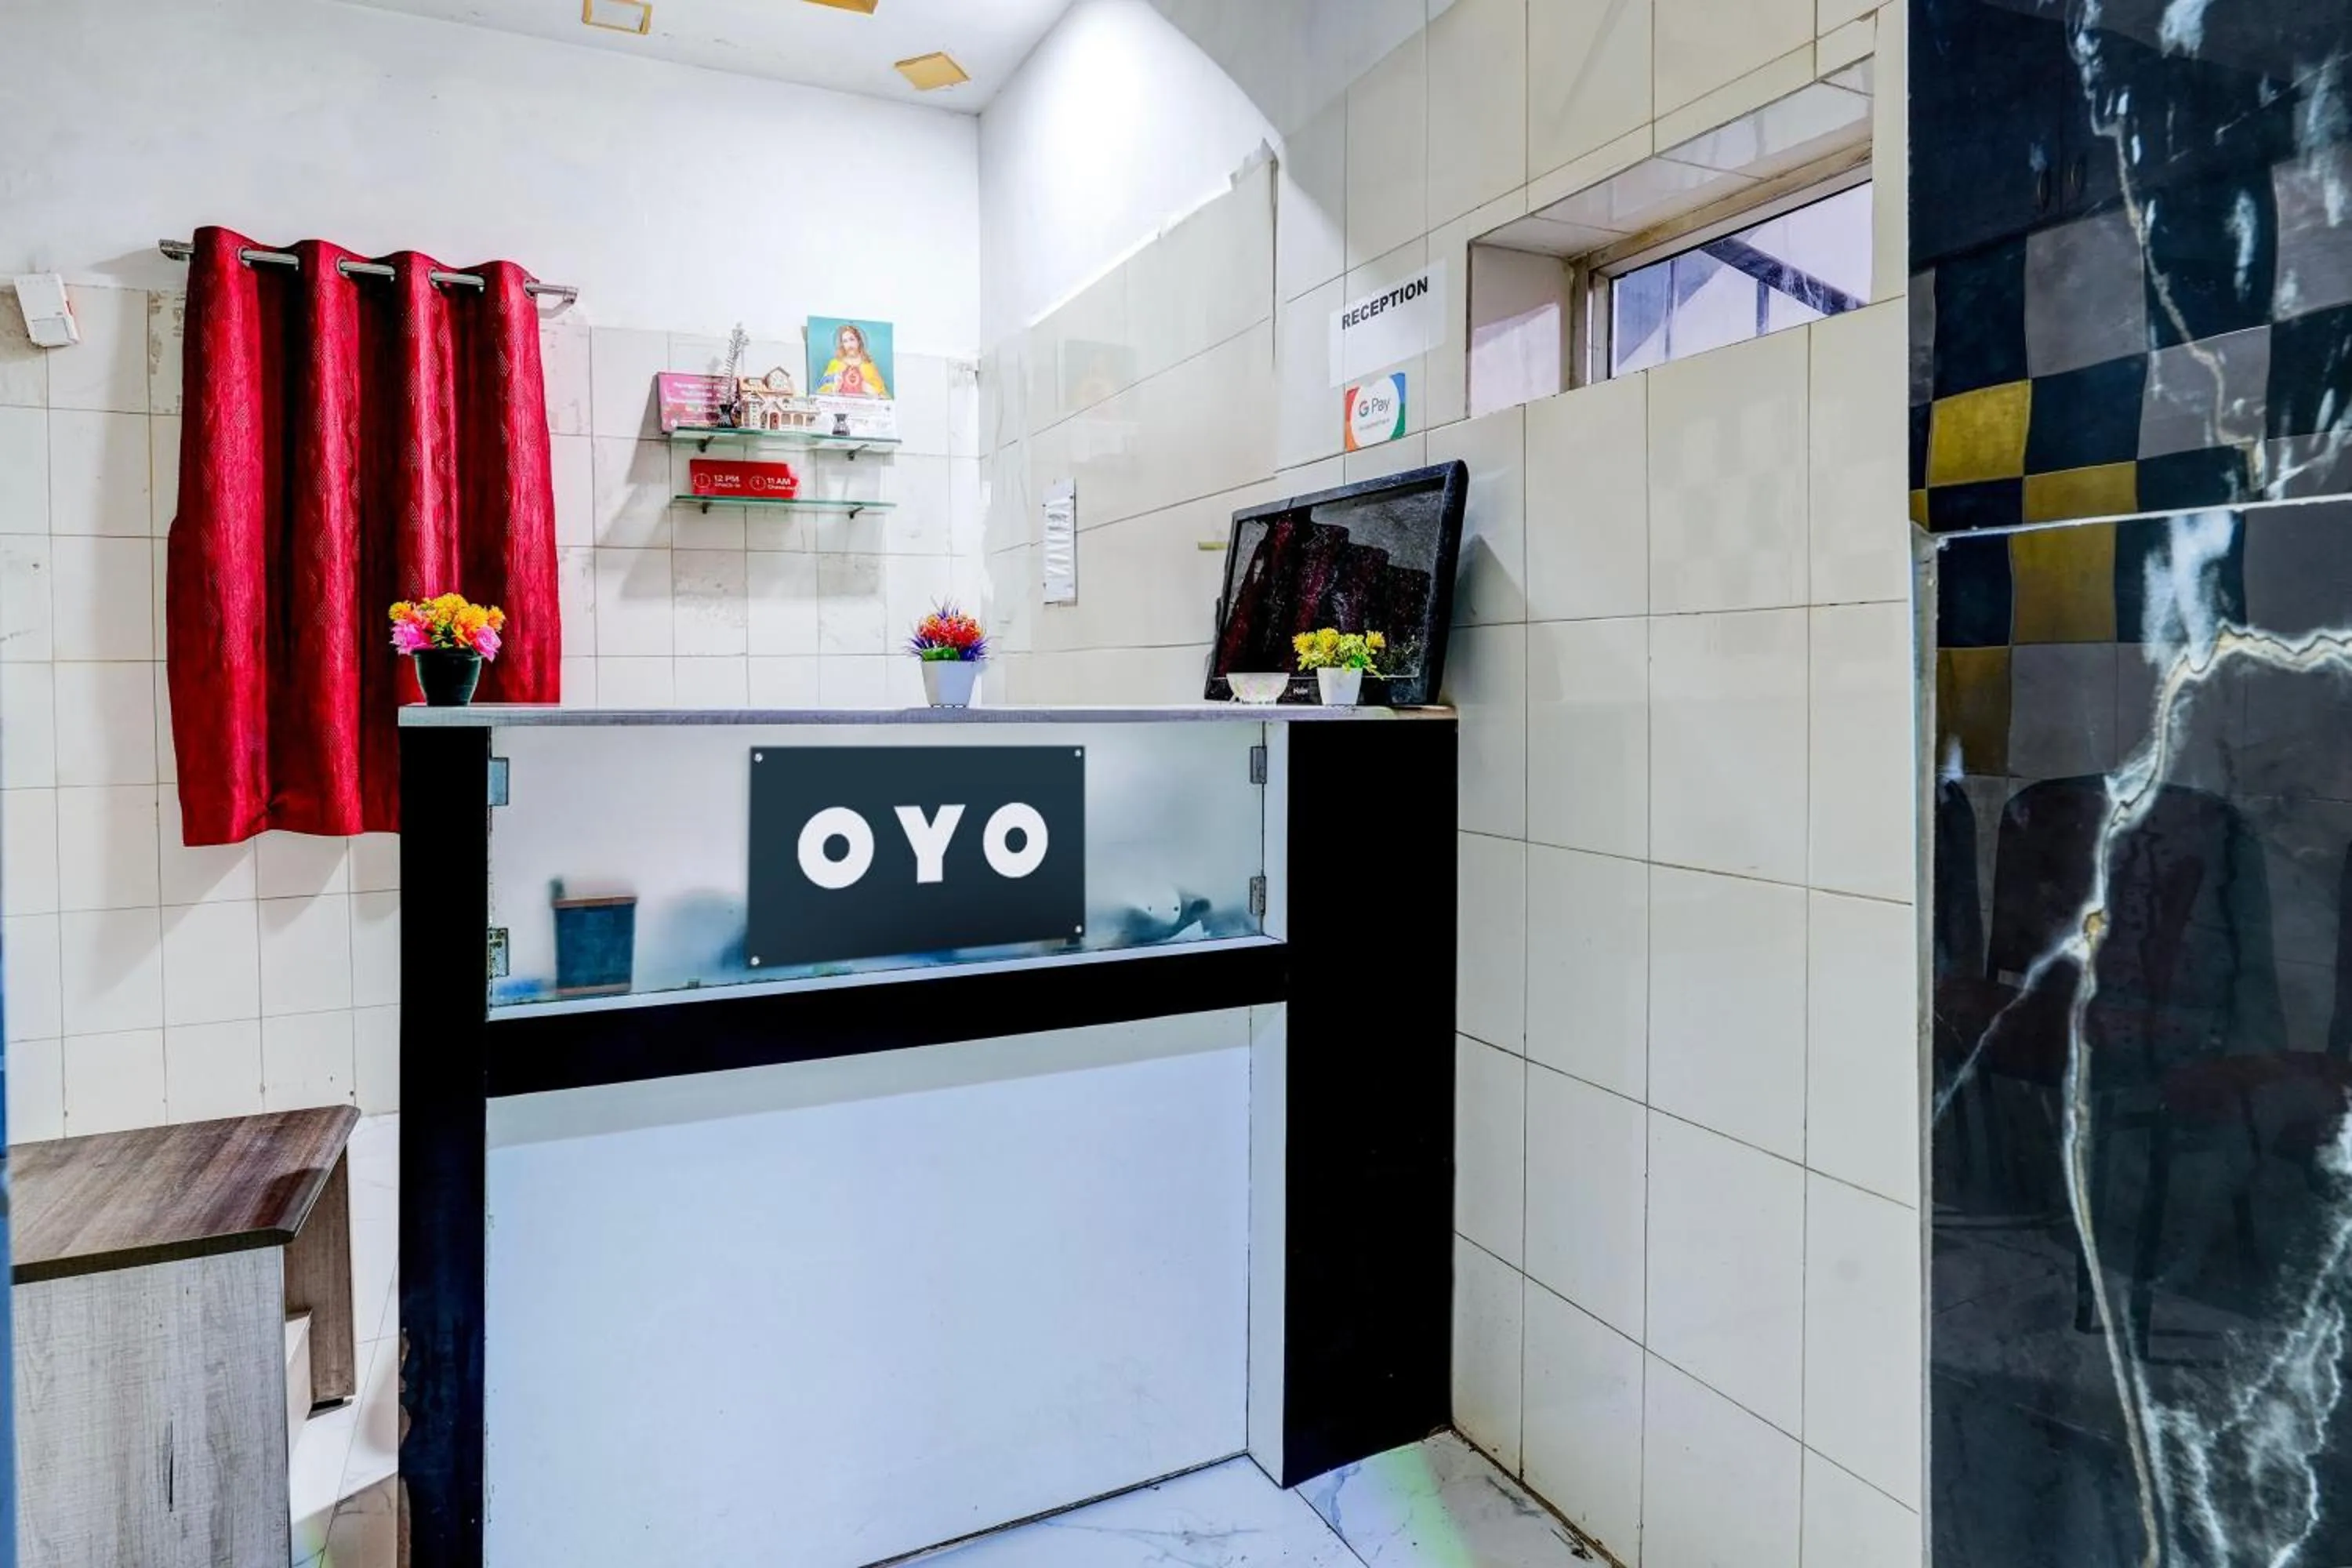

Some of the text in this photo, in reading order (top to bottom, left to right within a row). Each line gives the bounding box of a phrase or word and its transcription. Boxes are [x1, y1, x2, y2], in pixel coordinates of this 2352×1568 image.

[1341, 276, 1428, 330] RECEPTION
[1359, 397, 1390, 417] G Pay
[797, 801, 1049, 889] OYO
